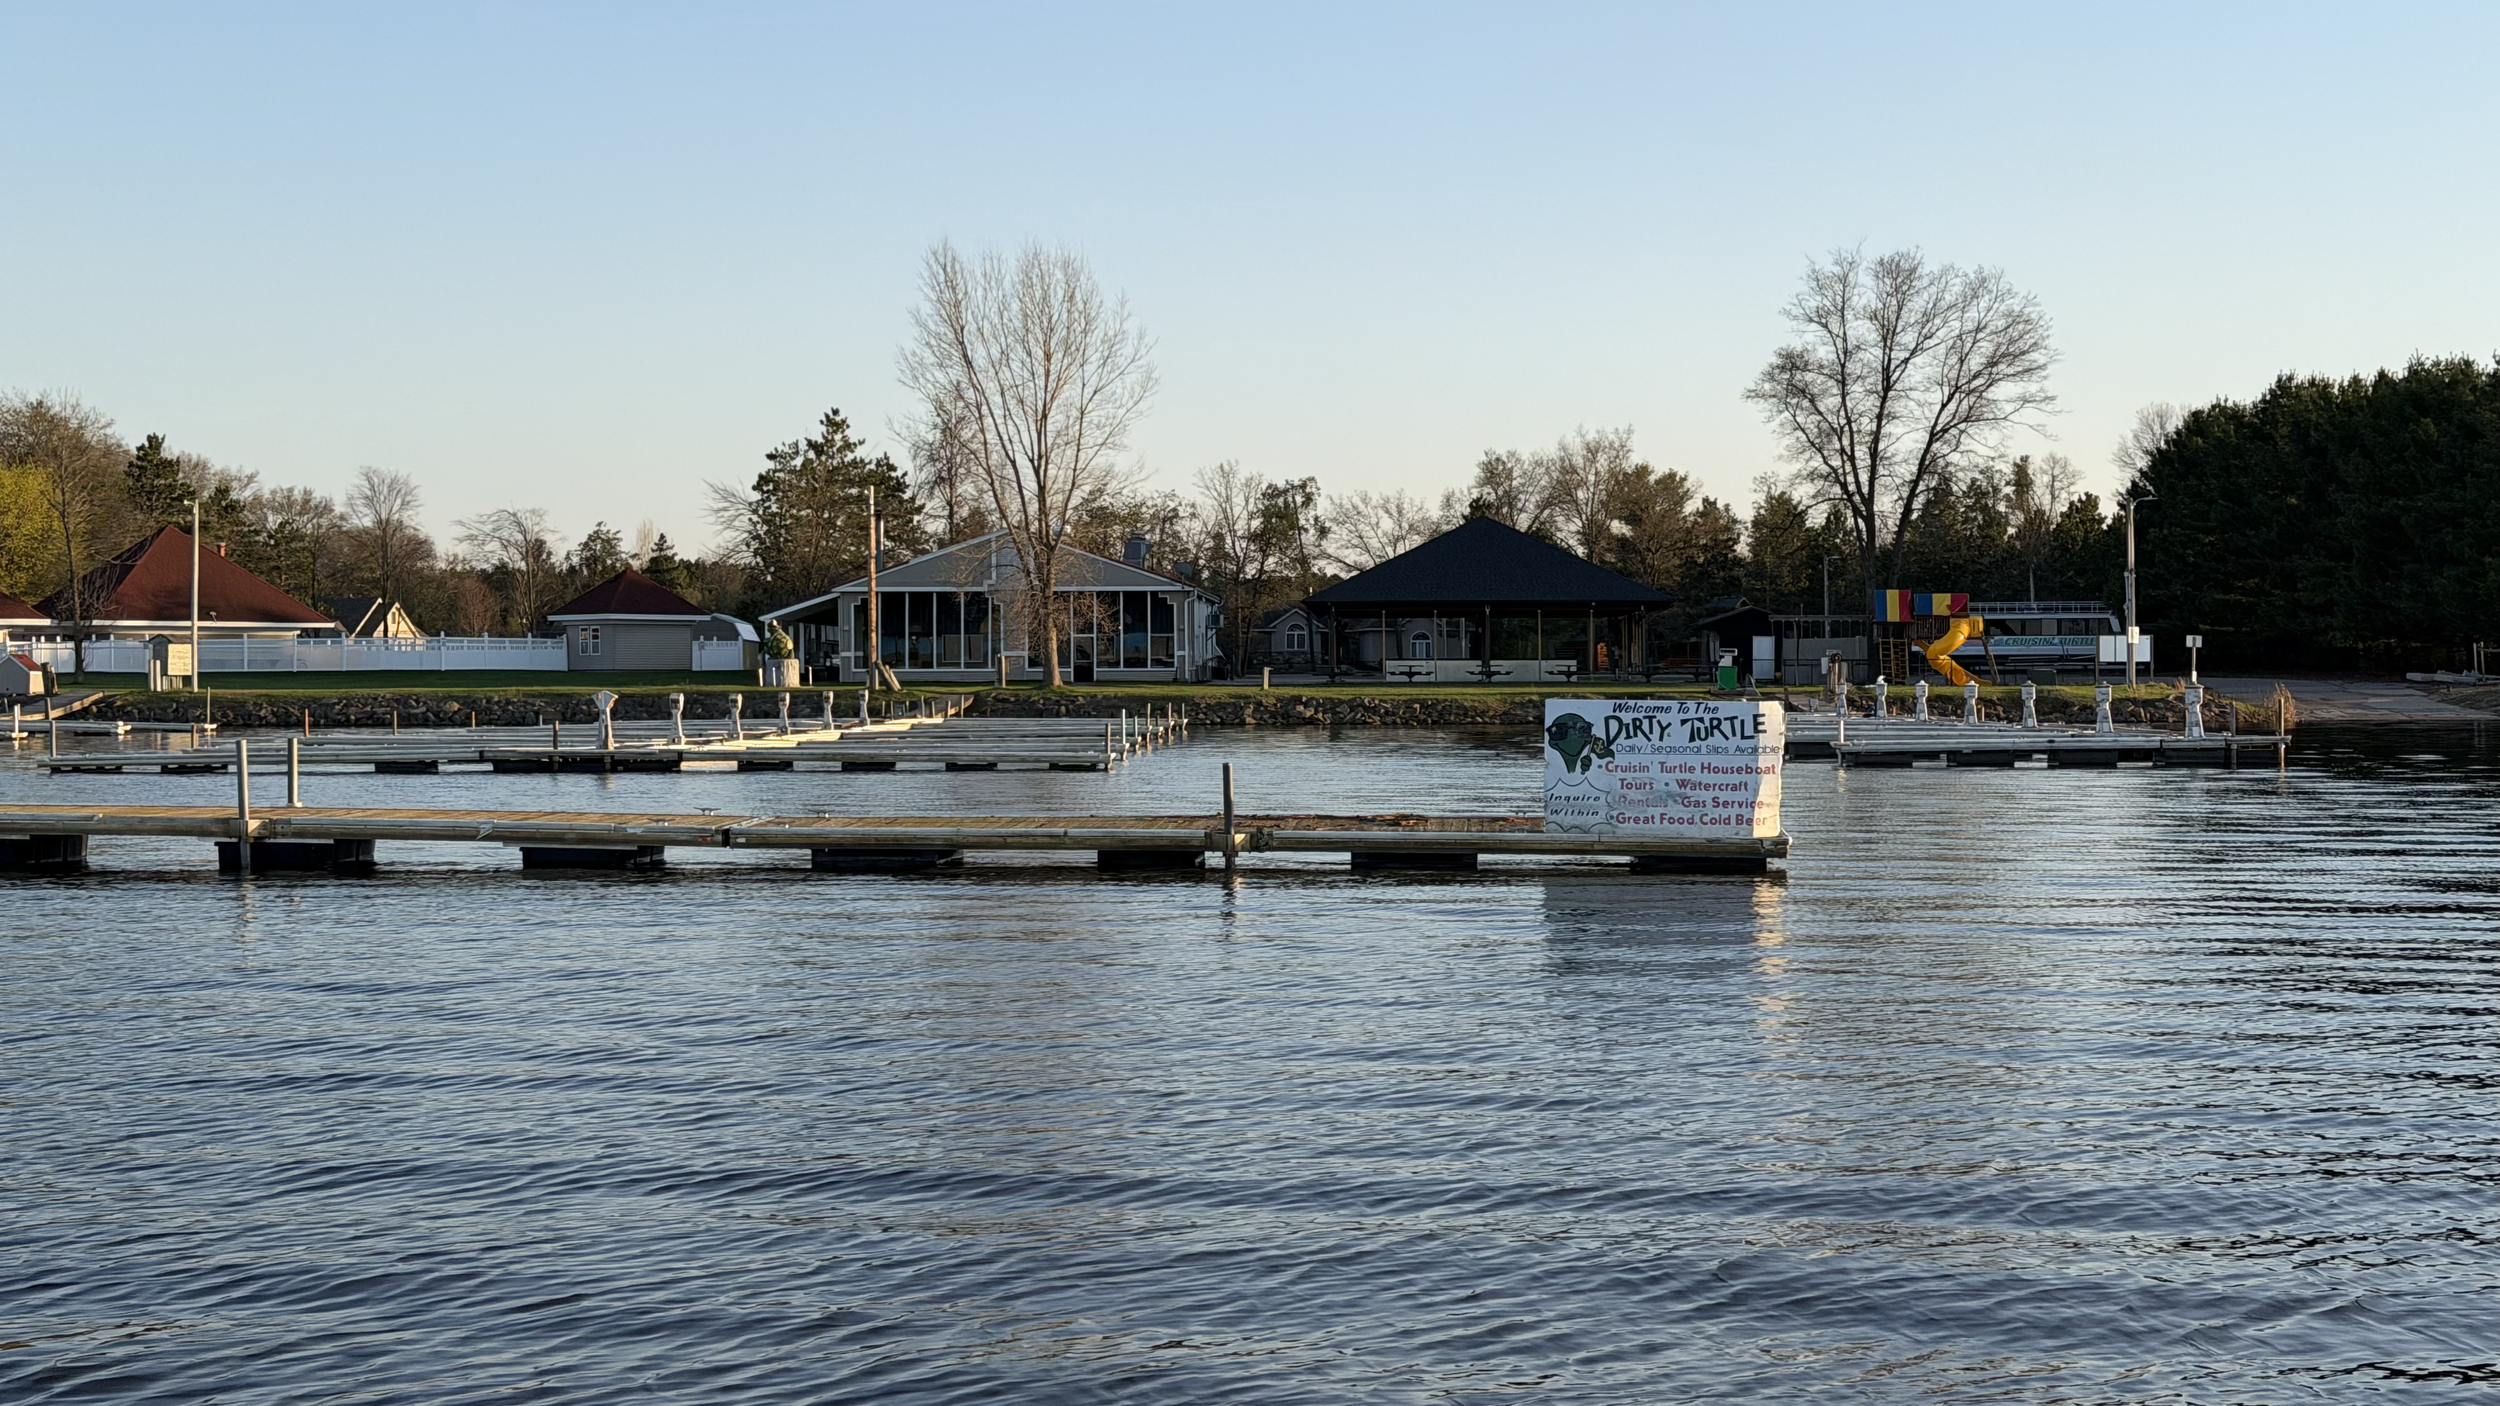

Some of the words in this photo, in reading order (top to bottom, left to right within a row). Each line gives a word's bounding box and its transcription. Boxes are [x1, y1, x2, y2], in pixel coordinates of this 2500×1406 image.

[1612, 702, 1672, 714] Welcome
[1677, 702, 1690, 714] To
[1694, 702, 1719, 714] The
[1604, 715, 1672, 747] DIRTY
[1680, 713, 1767, 743] TURTLE
[1705, 744, 1729, 755] Slips
[1734, 744, 1780, 754] Available
[1604, 760, 1653, 773] Cruisin'
[1658, 761, 1696, 774] Turtle
[1700, 762, 1776, 775] Houseboat
[1618, 778, 1654, 790] Tours
[1675, 778, 1749, 791] Watercraft
[1549, 793, 1601, 803] Inquire
[1681, 796, 1707, 808] Gas
[1711, 796, 1764, 809] Service
[1550, 808, 1600, 817] Within
[1615, 812, 1656, 825] Great
[1699, 813, 1731, 826] Cold
[1735, 813, 1767, 827] Beer
